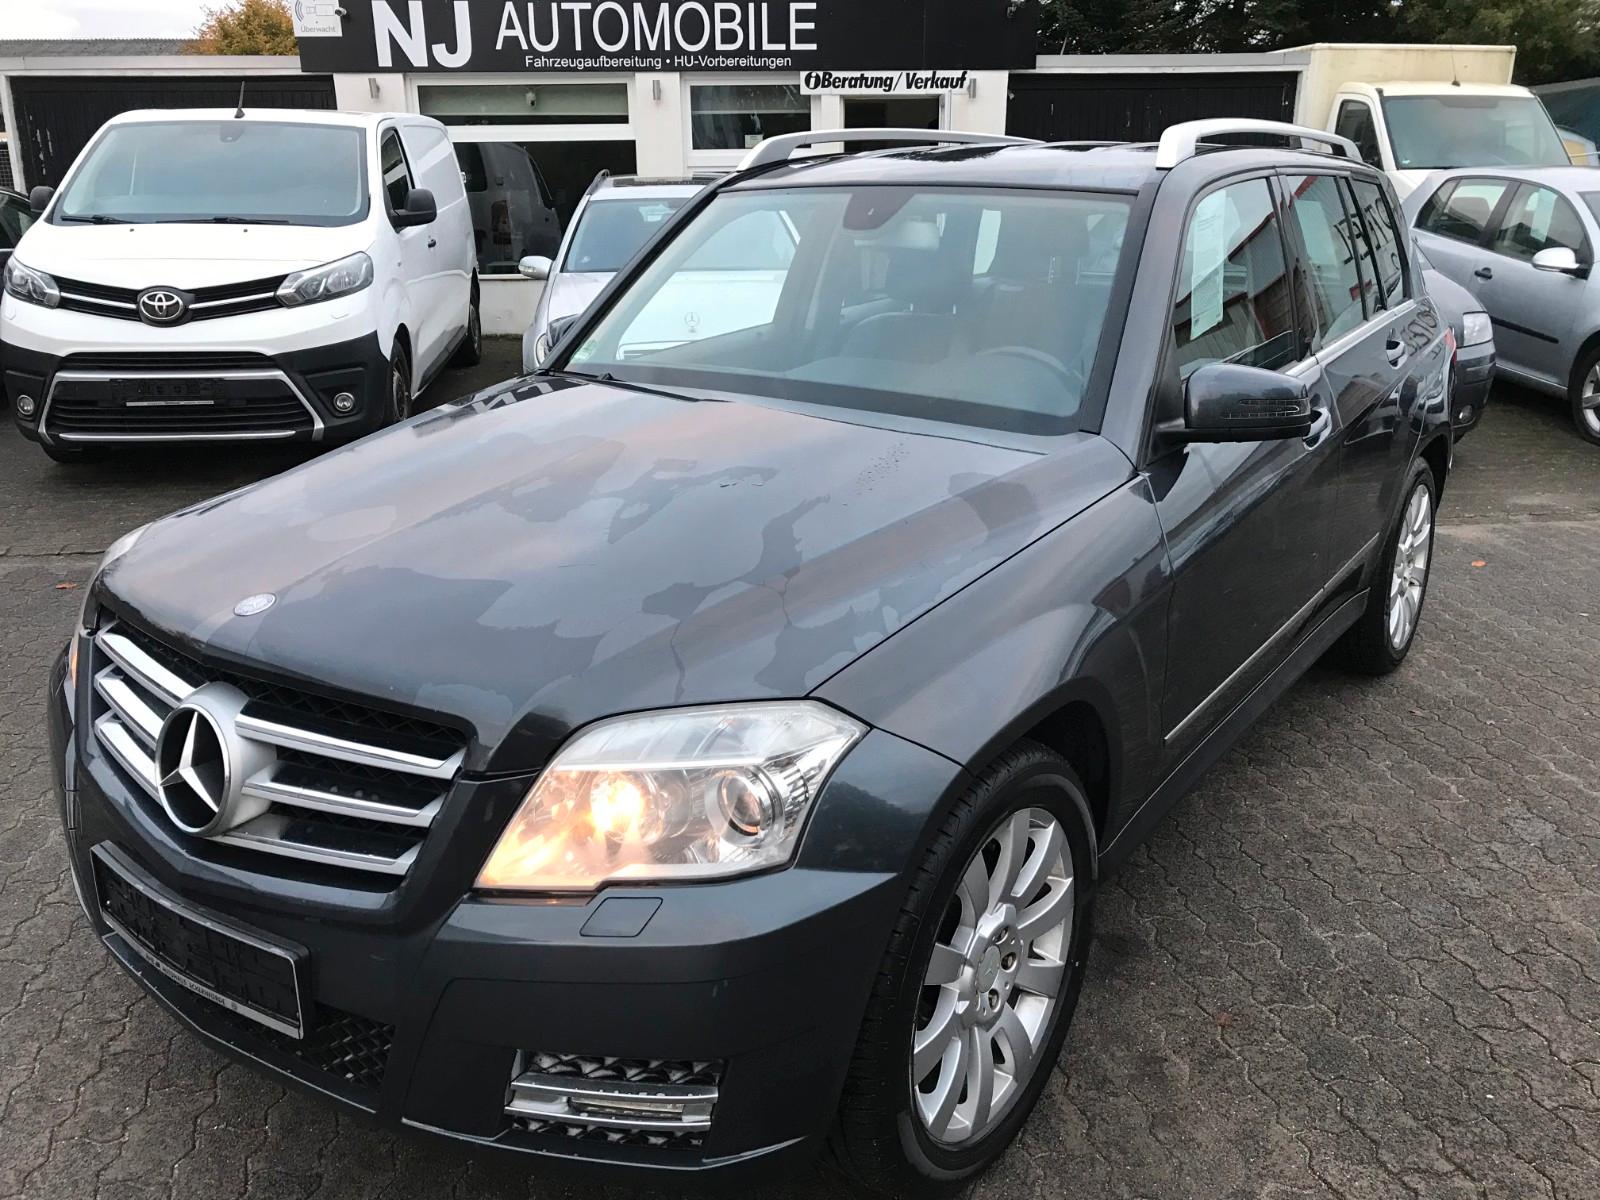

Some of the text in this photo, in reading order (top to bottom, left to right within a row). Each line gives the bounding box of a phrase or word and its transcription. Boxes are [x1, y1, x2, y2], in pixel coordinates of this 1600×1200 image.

[371, 0, 818, 68] NJ AUTOMOBILE
[525, 55, 792, 71] Fahrzeugaufbereitung HU-Vorbereitungen
[905, 71, 968, 90] Verkauf
